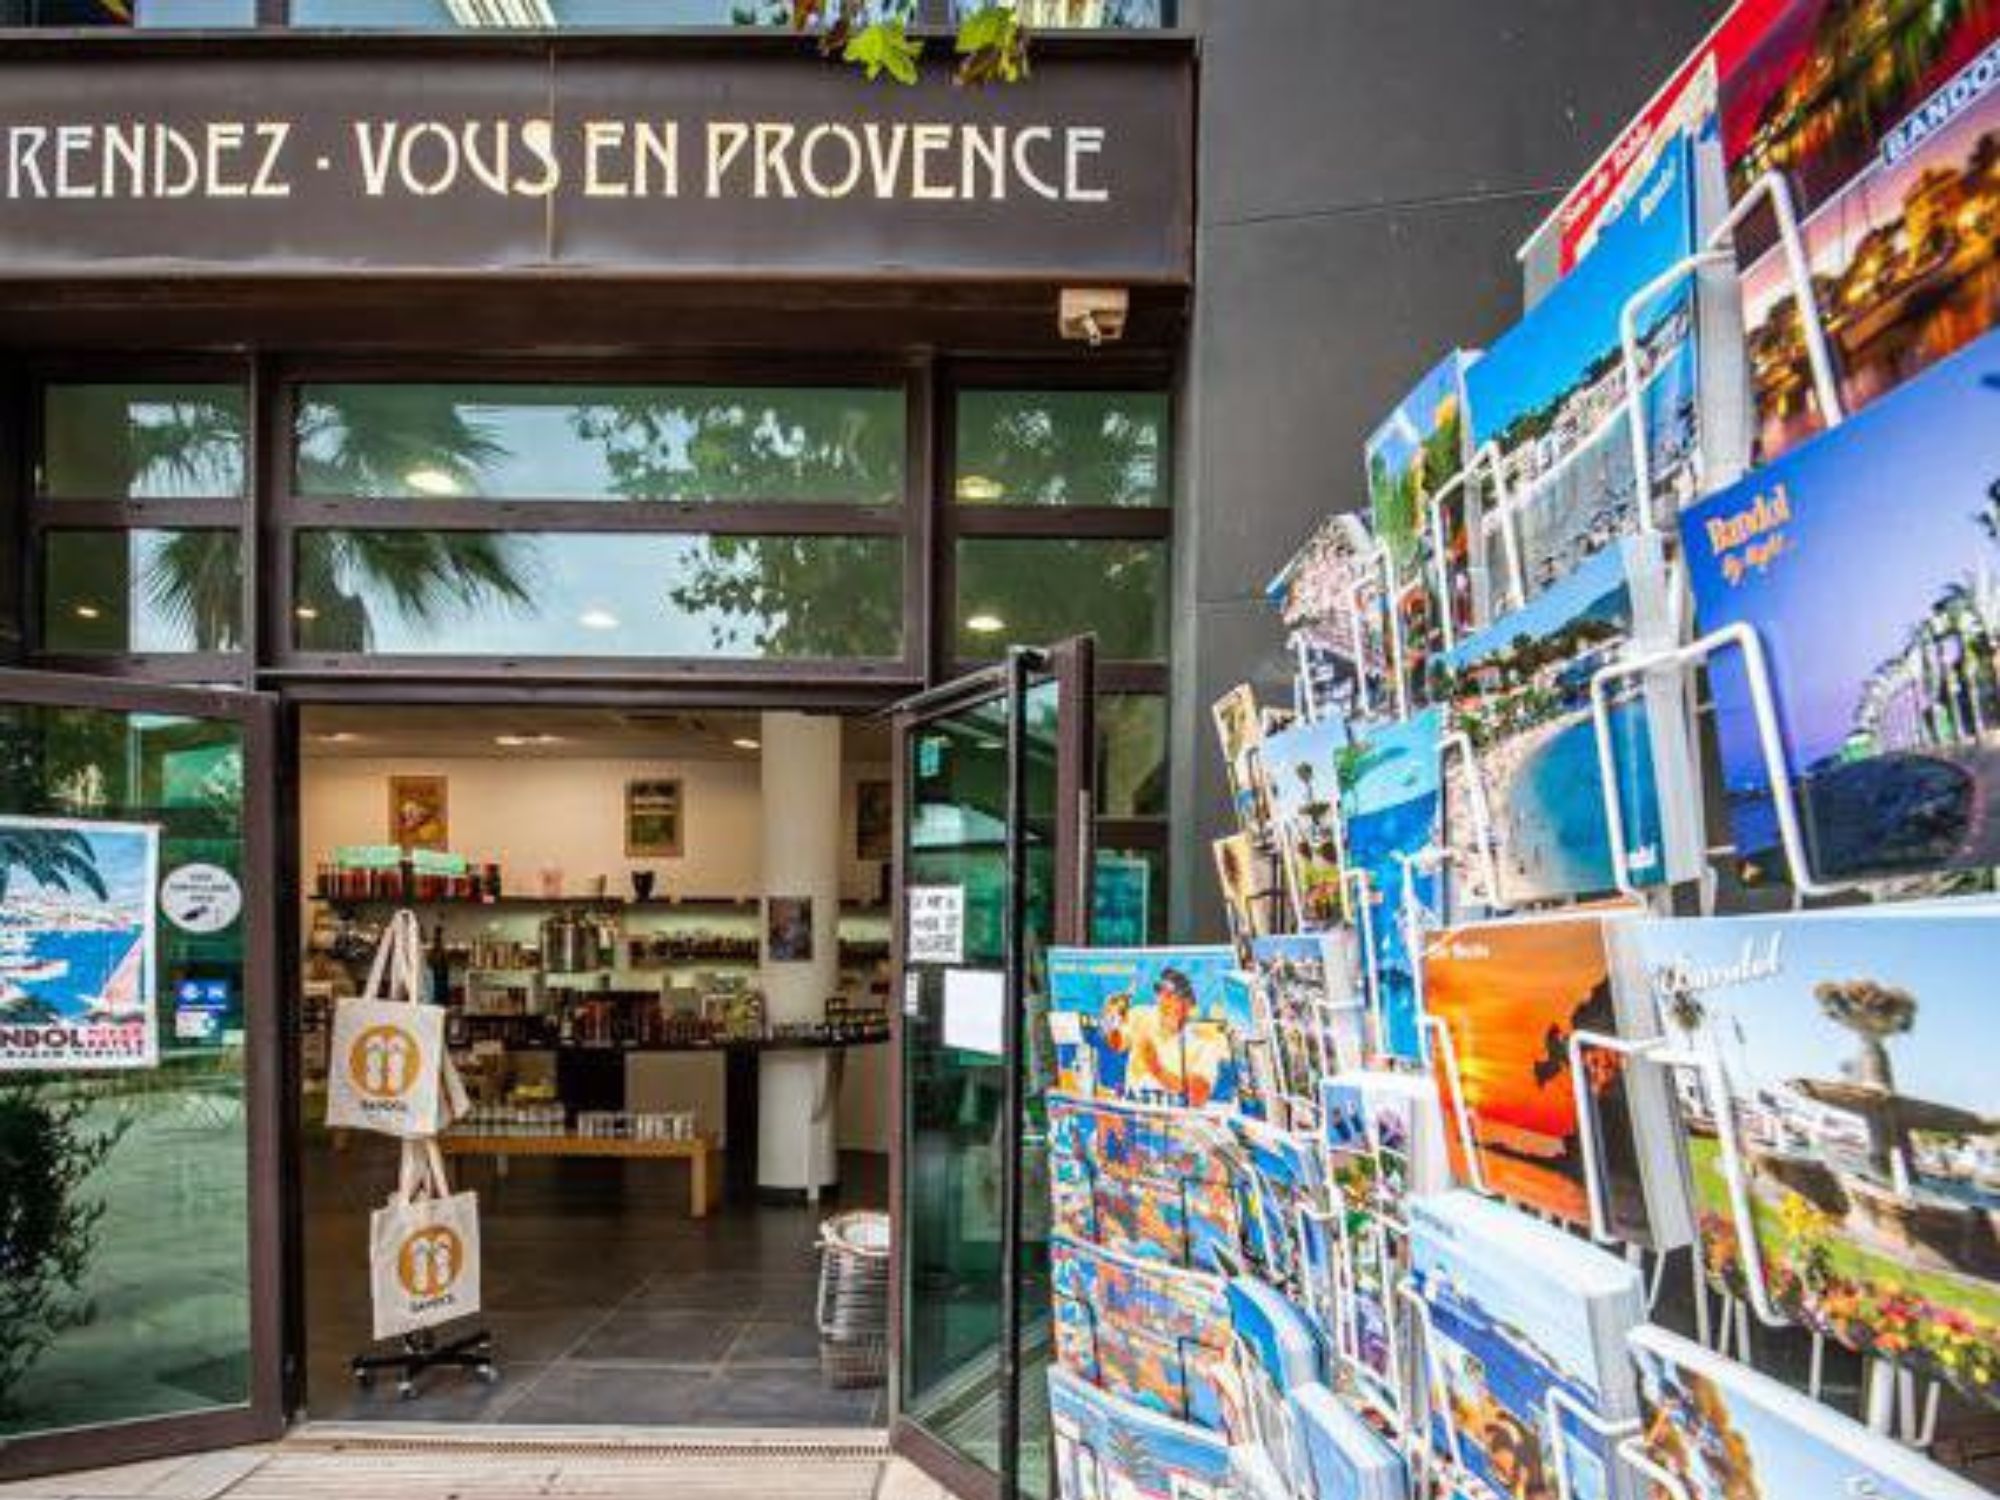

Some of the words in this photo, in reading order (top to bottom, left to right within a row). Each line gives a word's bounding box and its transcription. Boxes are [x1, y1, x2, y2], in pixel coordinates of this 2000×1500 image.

[8, 124, 290, 198] RENDEZ
[355, 121, 561, 196] VOUS
[584, 122, 678, 197] EN
[706, 122, 1109, 201] PROVENCE
